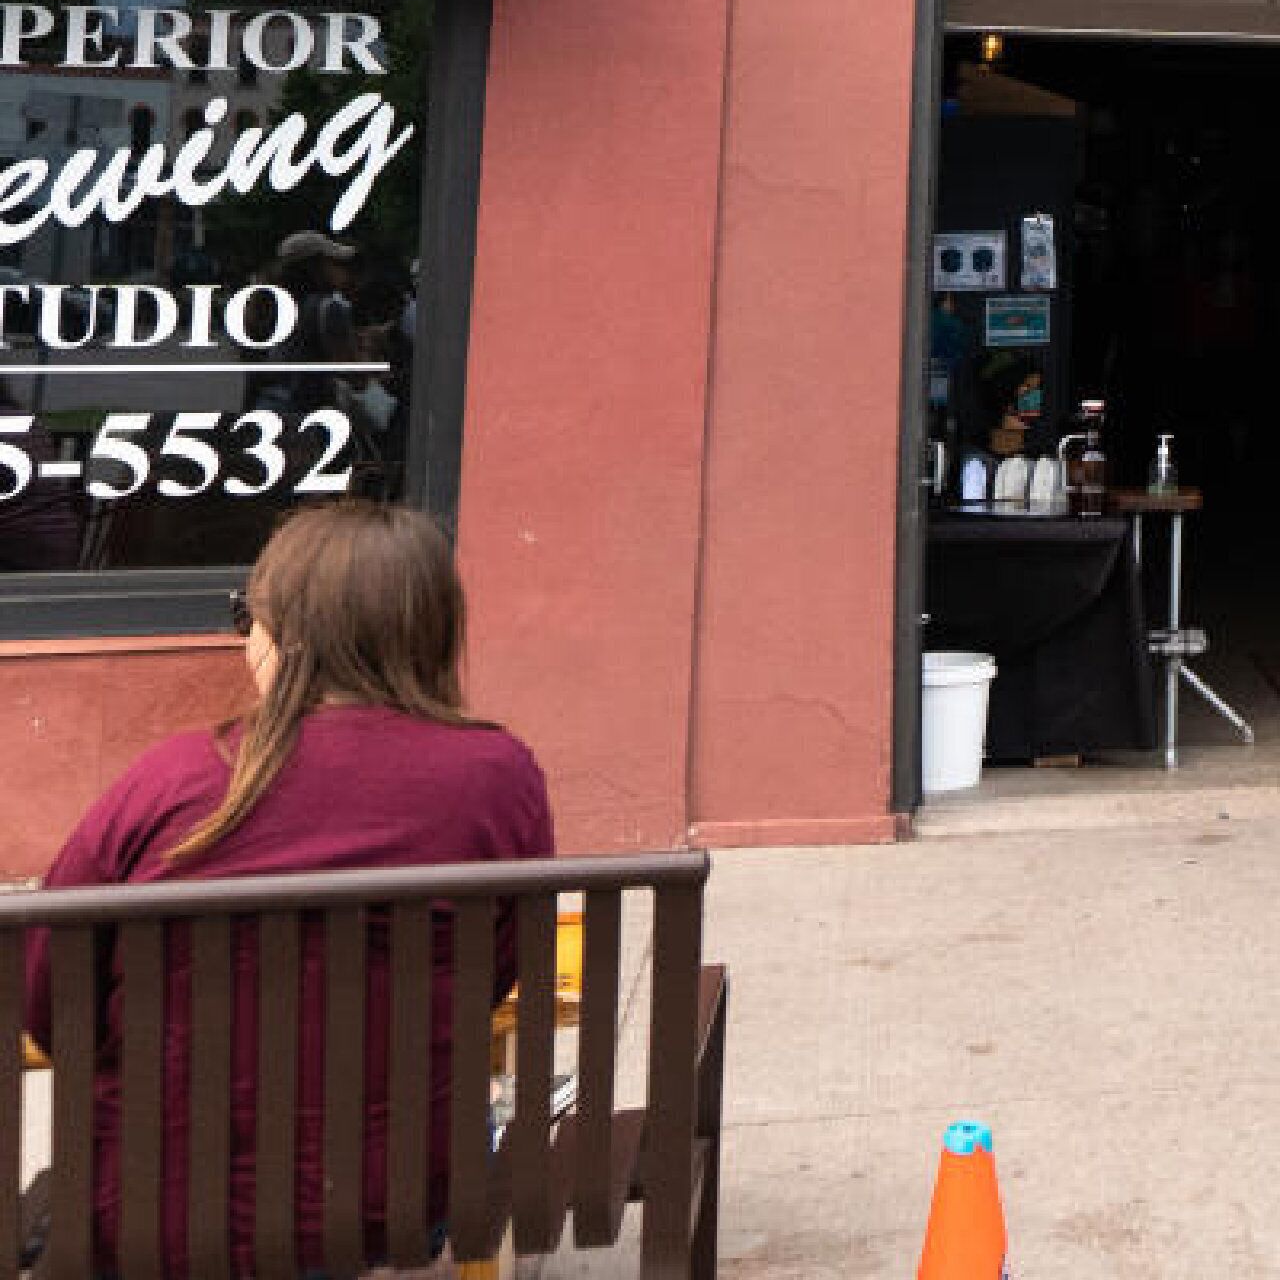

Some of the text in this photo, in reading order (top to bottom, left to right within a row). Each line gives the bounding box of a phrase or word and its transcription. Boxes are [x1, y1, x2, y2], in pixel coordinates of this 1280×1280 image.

[0, 3, 388, 75] PERIOR
[0, 92, 415, 246] ewing
[0, 409, 353, 500] 5-5532
